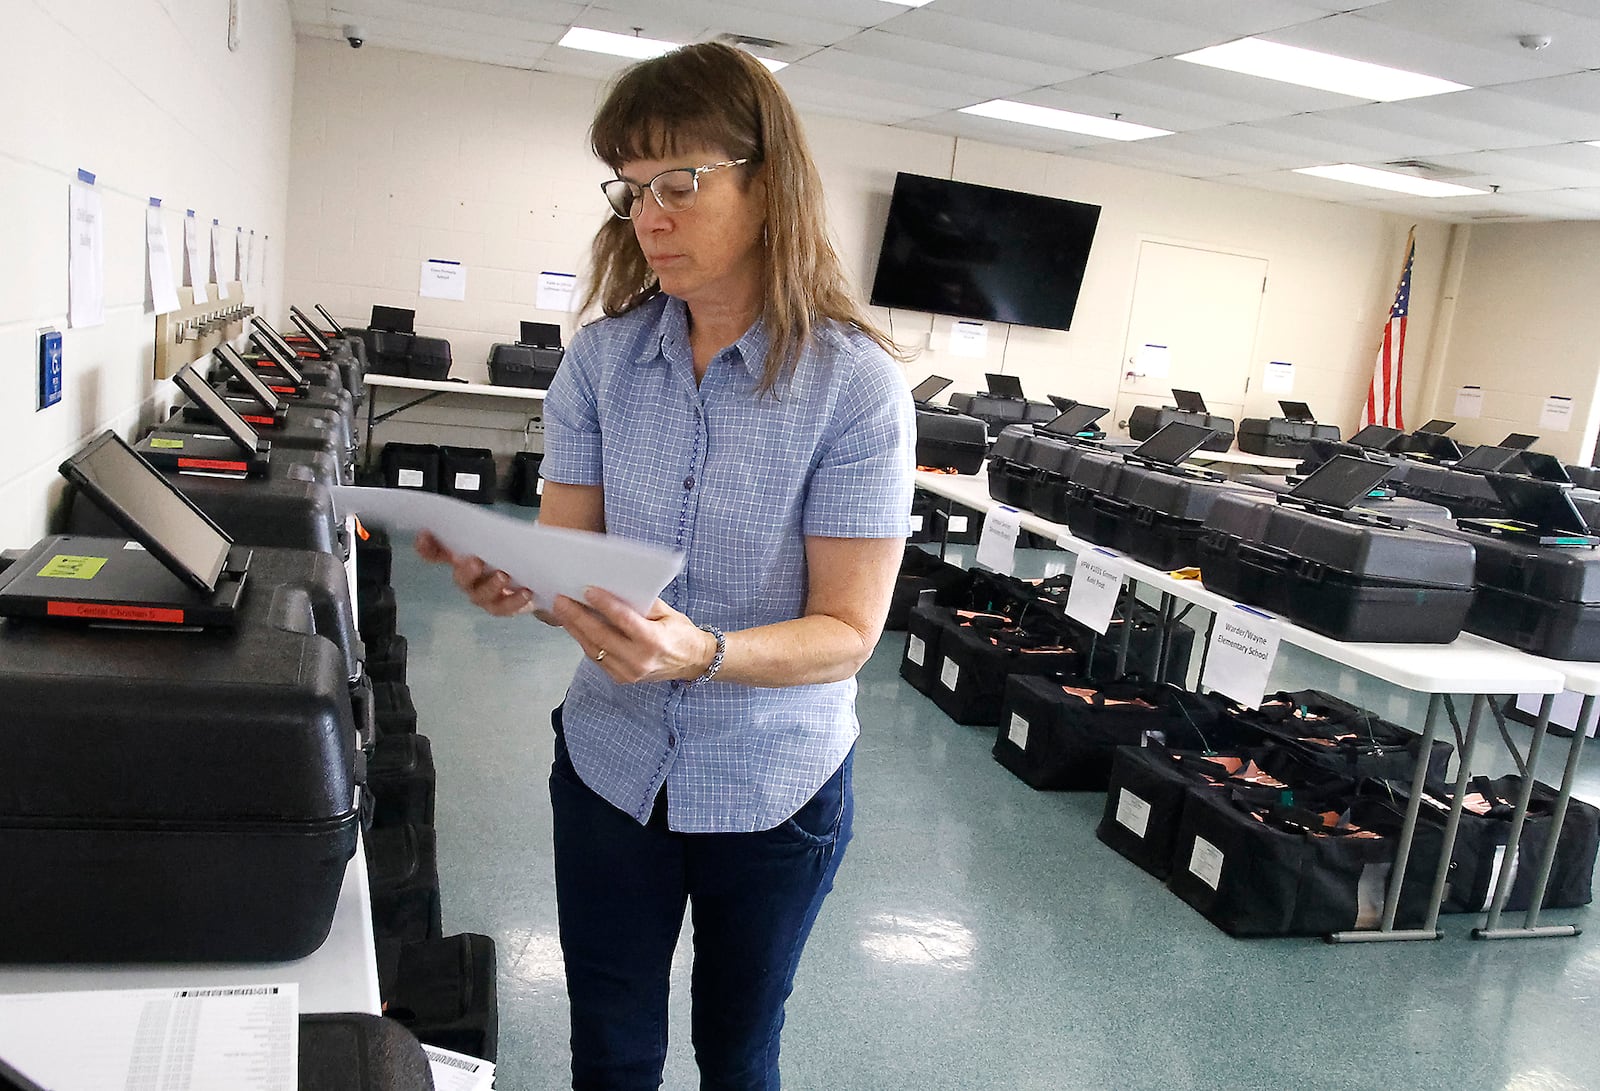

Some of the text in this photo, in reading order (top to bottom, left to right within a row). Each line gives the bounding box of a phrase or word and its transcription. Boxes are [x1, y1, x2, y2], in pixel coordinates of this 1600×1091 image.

[77, 605, 109, 617] Central
[1225, 622, 1268, 646] Warder/Wayne
[1217, 634, 1269, 659] Elementary School
